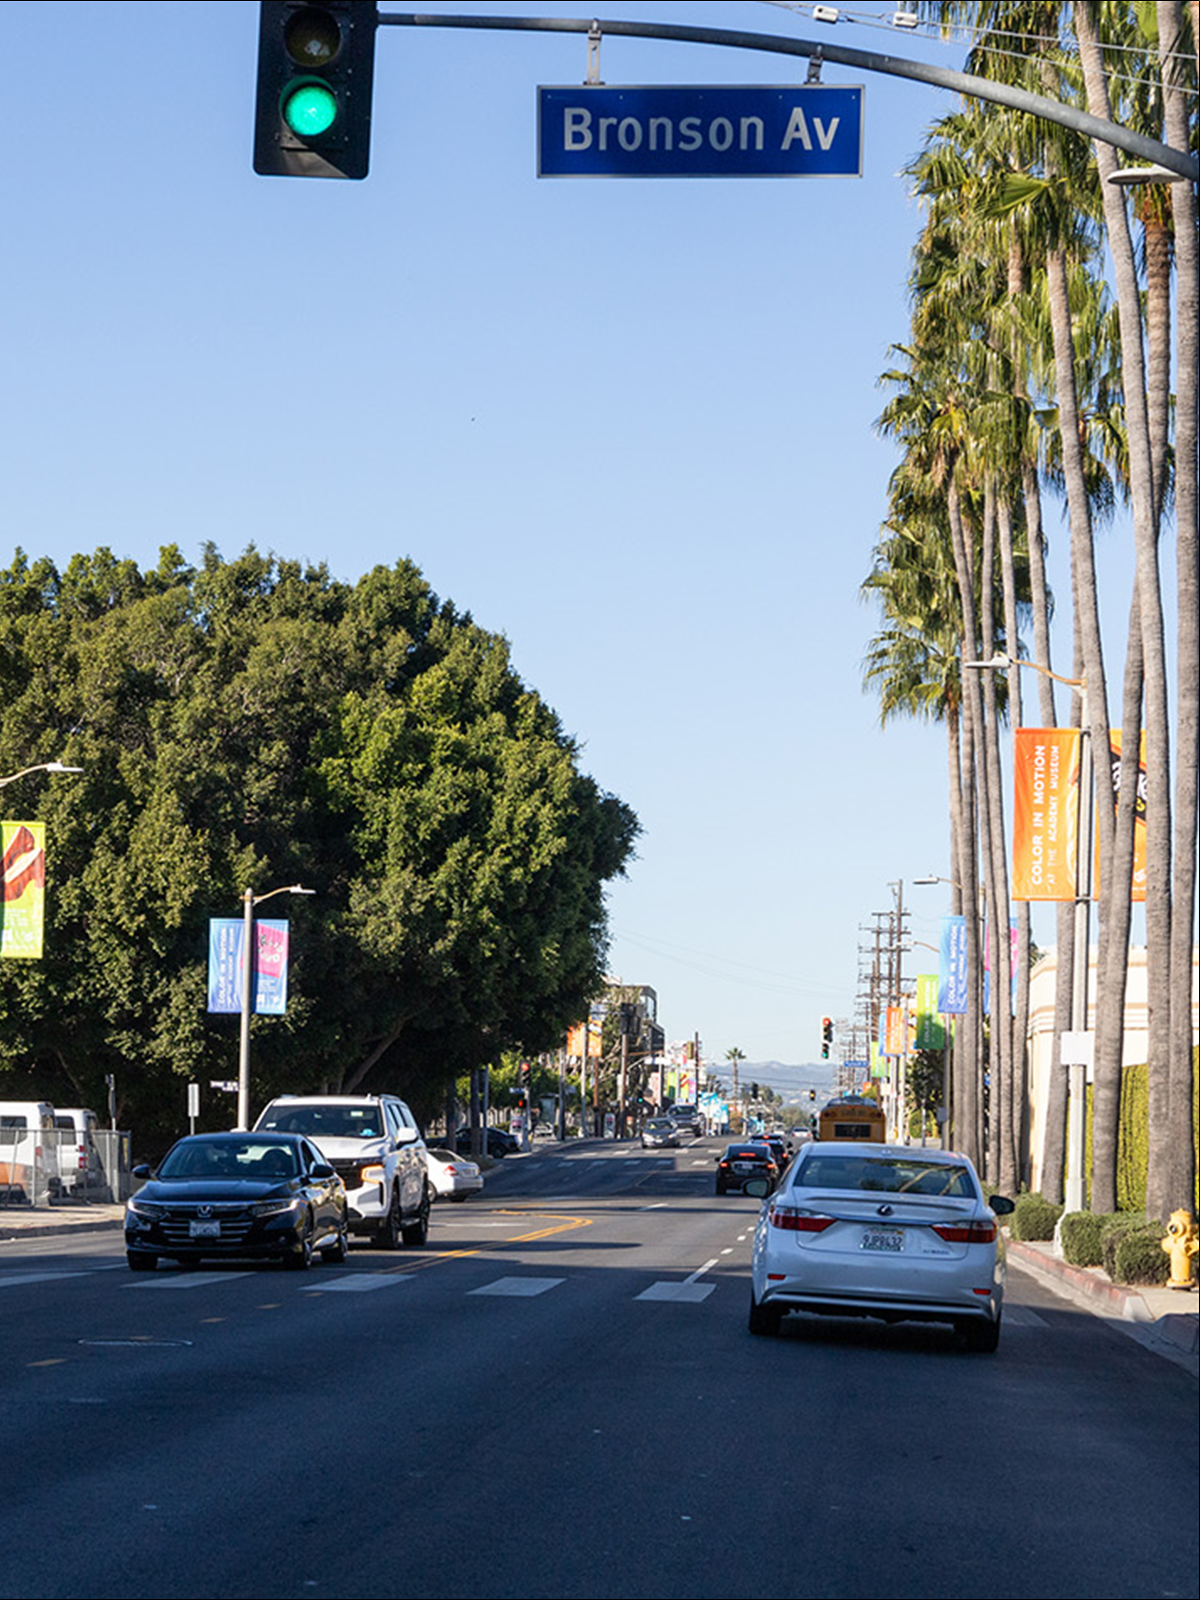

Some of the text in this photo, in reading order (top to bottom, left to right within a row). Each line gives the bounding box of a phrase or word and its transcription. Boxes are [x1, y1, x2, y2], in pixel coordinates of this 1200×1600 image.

[564, 106, 840, 151] Bronson Av
[1031, 744, 1046, 886] COLOR IN MOTION
[1046, 745, 1060, 885] AT THE ACADEMY MUSEUM
[950, 924, 958, 960] MOTION
[947, 975, 956, 1005] COLOR
